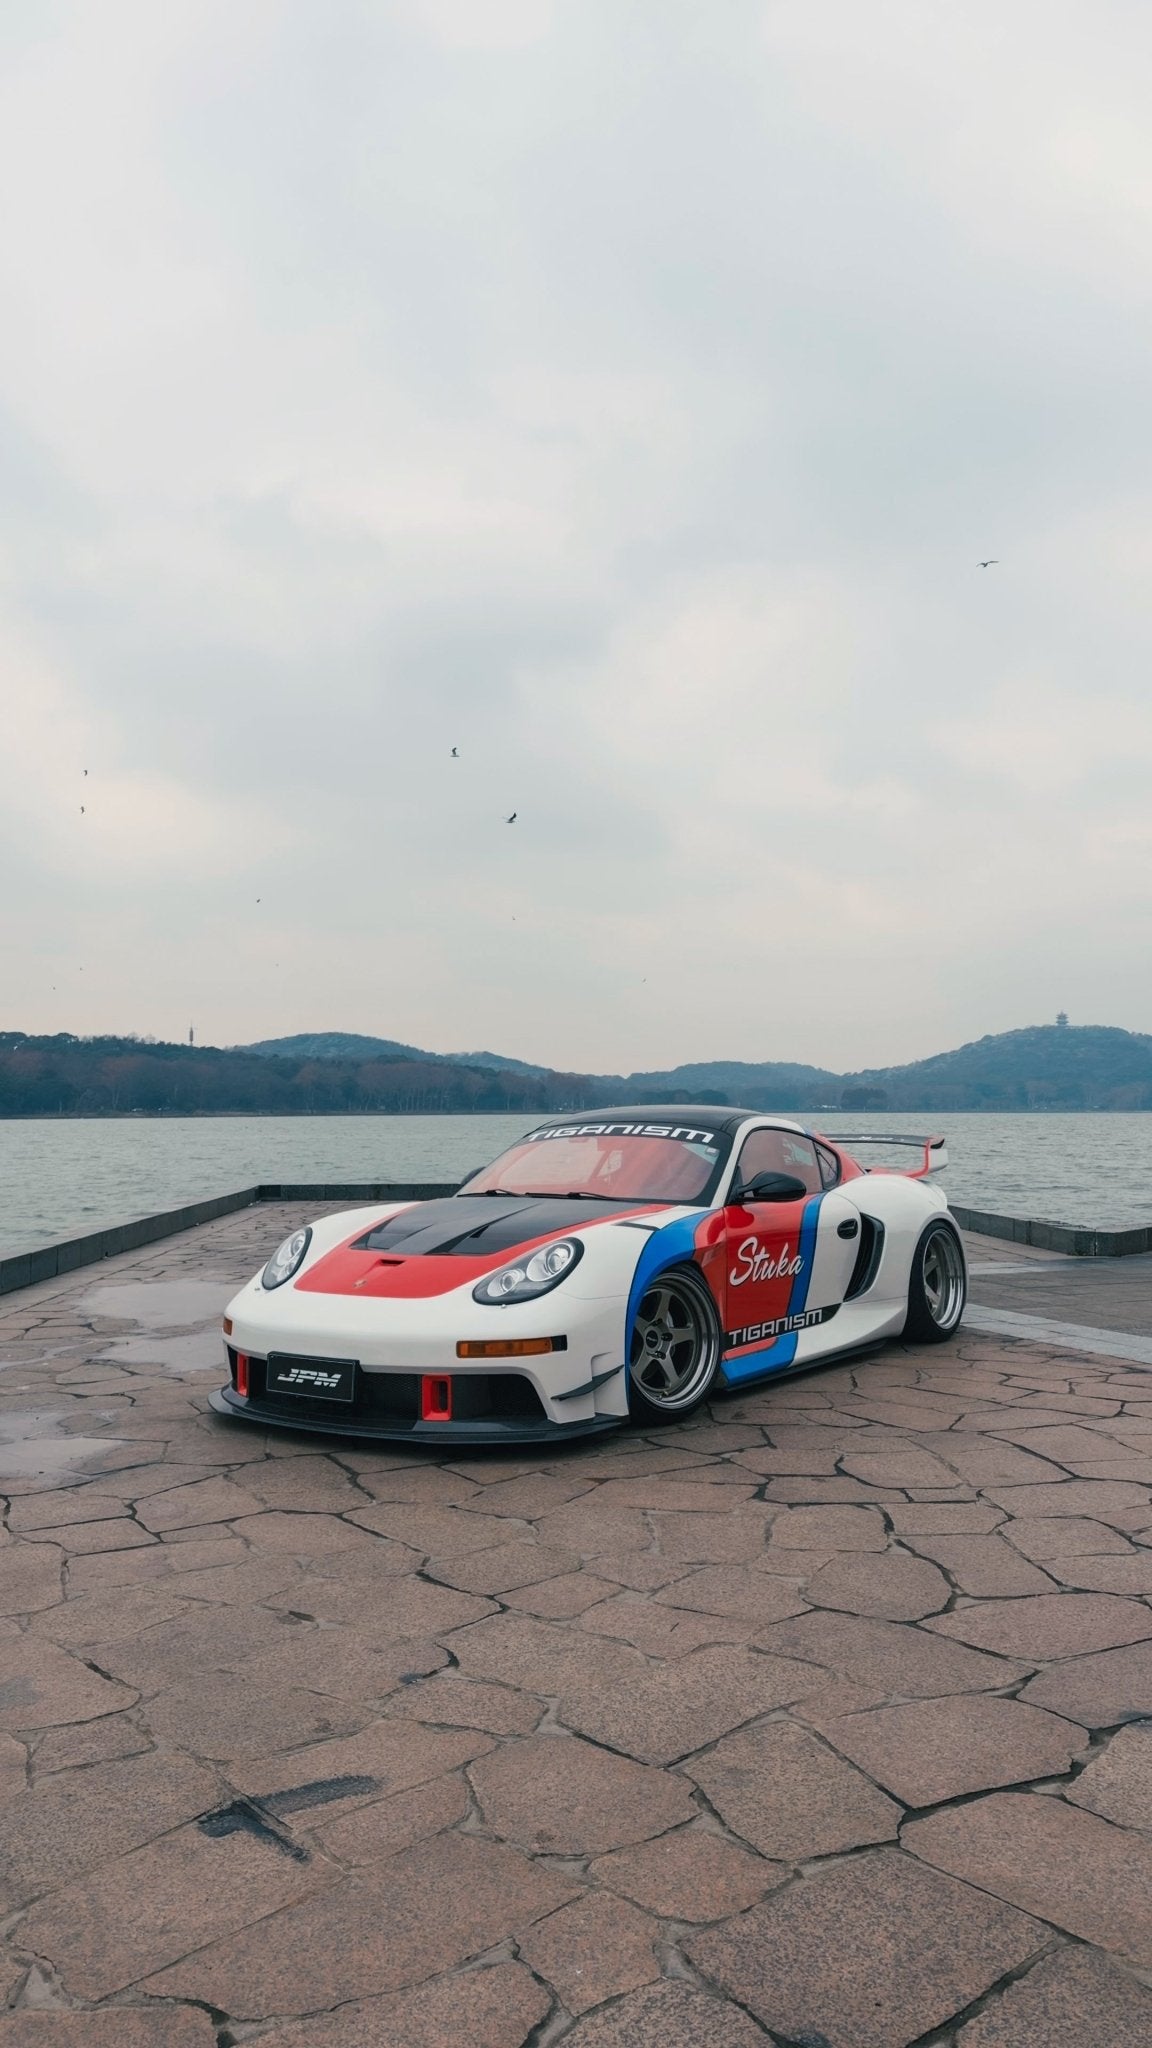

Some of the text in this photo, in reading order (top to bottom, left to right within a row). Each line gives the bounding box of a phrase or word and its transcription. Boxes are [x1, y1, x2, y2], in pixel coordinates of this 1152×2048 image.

[528, 1125, 714, 1143] TIGANISM
[729, 1236, 805, 1286] Stuka
[729, 1309, 822, 1345] TIGANISM
[277, 1368, 342, 1388] JPM
